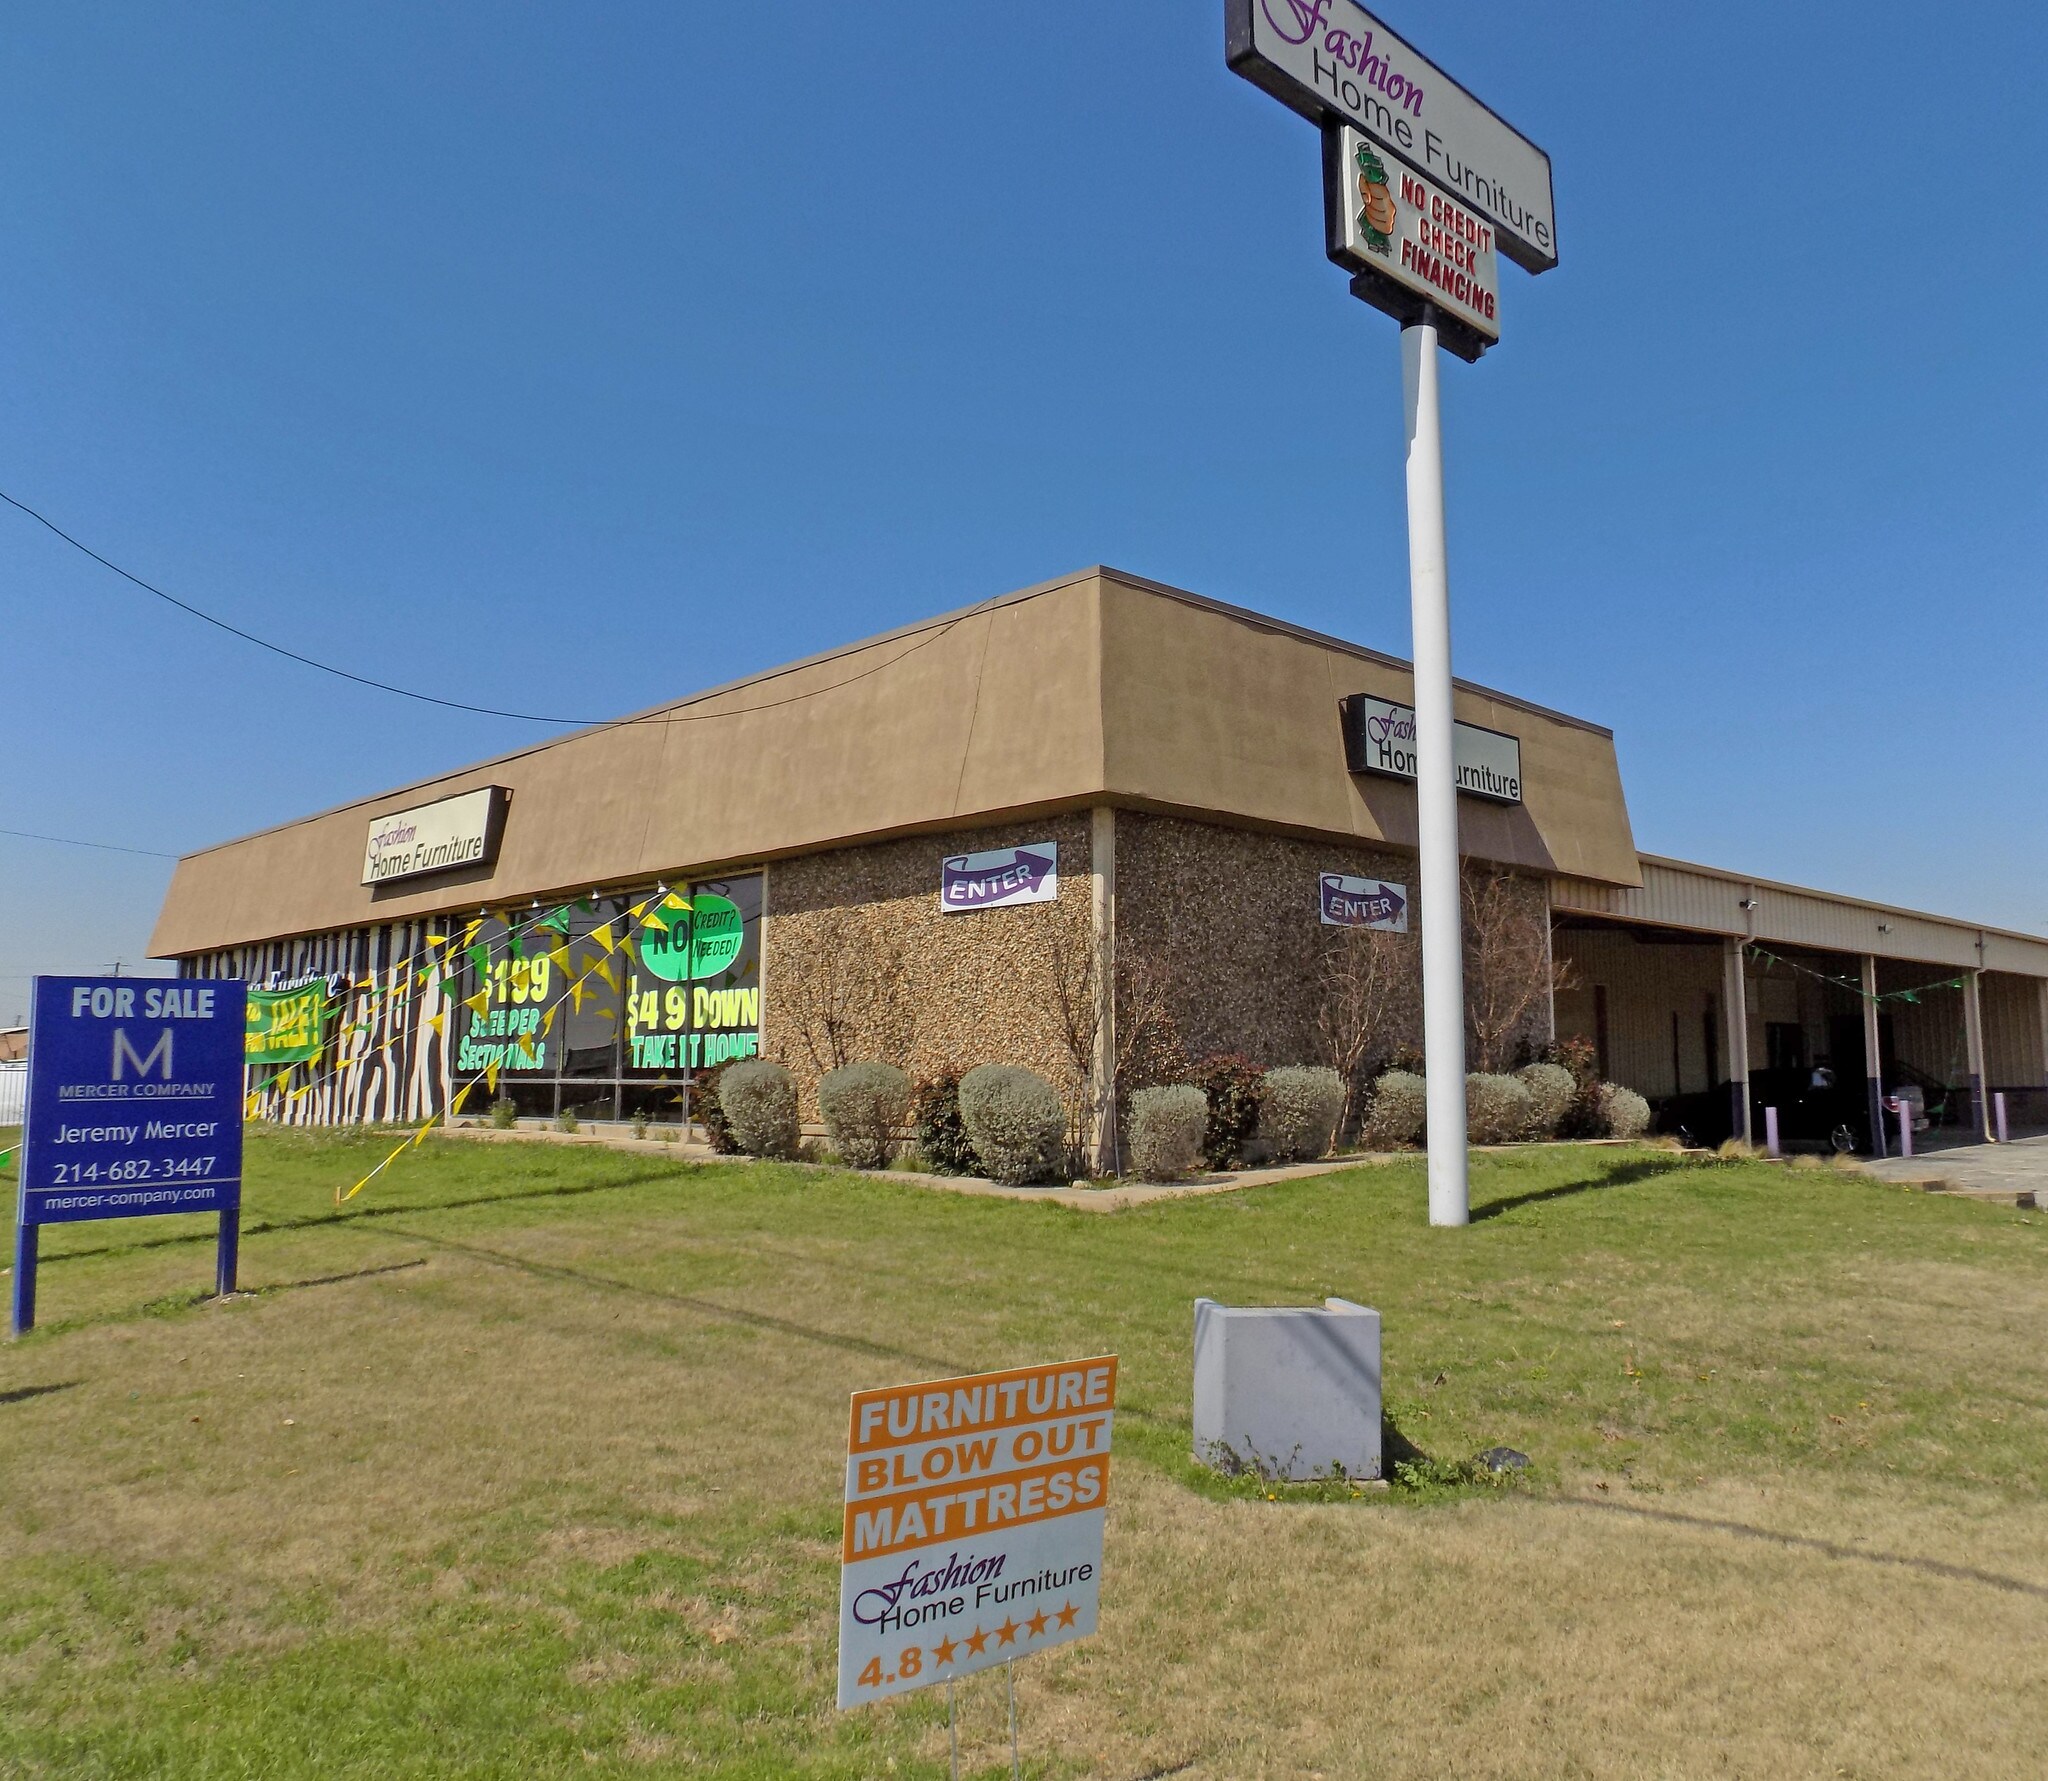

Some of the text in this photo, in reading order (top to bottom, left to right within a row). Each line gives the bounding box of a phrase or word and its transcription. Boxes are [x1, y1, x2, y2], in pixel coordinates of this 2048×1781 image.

[1261, 0, 1424, 118] Fashion
[1313, 47, 1550, 248] Home Furniture
[1400, 170, 1491, 253] NO CREDIT
[1418, 216, 1476, 277] CHECK
[1400, 236, 1495, 321] FINANCING
[1367, 707, 1416, 744] Fash
[1378, 739, 1519, 798] Hom urniture
[368, 820, 417, 860] Fashion
[370, 835, 482, 879] Home Furniture
[949, 864, 1033, 900] ENTER
[1329, 896, 1392, 918] ENTER
[653, 919, 688, 955] NO
[71, 986, 215, 1019] FOR SALE
[112, 1027, 174, 1081] M
[630, 1034, 676, 1069] TAKE
[678, 1034, 701, 1069] IT
[59, 1083, 215, 1098] MERCER COMPANY
[54, 1120, 218, 1145] Jeremy Mercer
[53, 1156, 217, 1184] 214-682-3447
[45, 1187, 216, 1210] mercer-company.com
[859, 1366, 1110, 1444] FURNITURE
[857, 1418, 1107, 1494] BLOW OUT
[853, 1466, 1101, 1553] MATTRESS
[853, 1552, 1007, 1625] Fashion
[880, 1563, 1094, 1635] Home Furniture
[857, 1646, 923, 1687] 4.8
